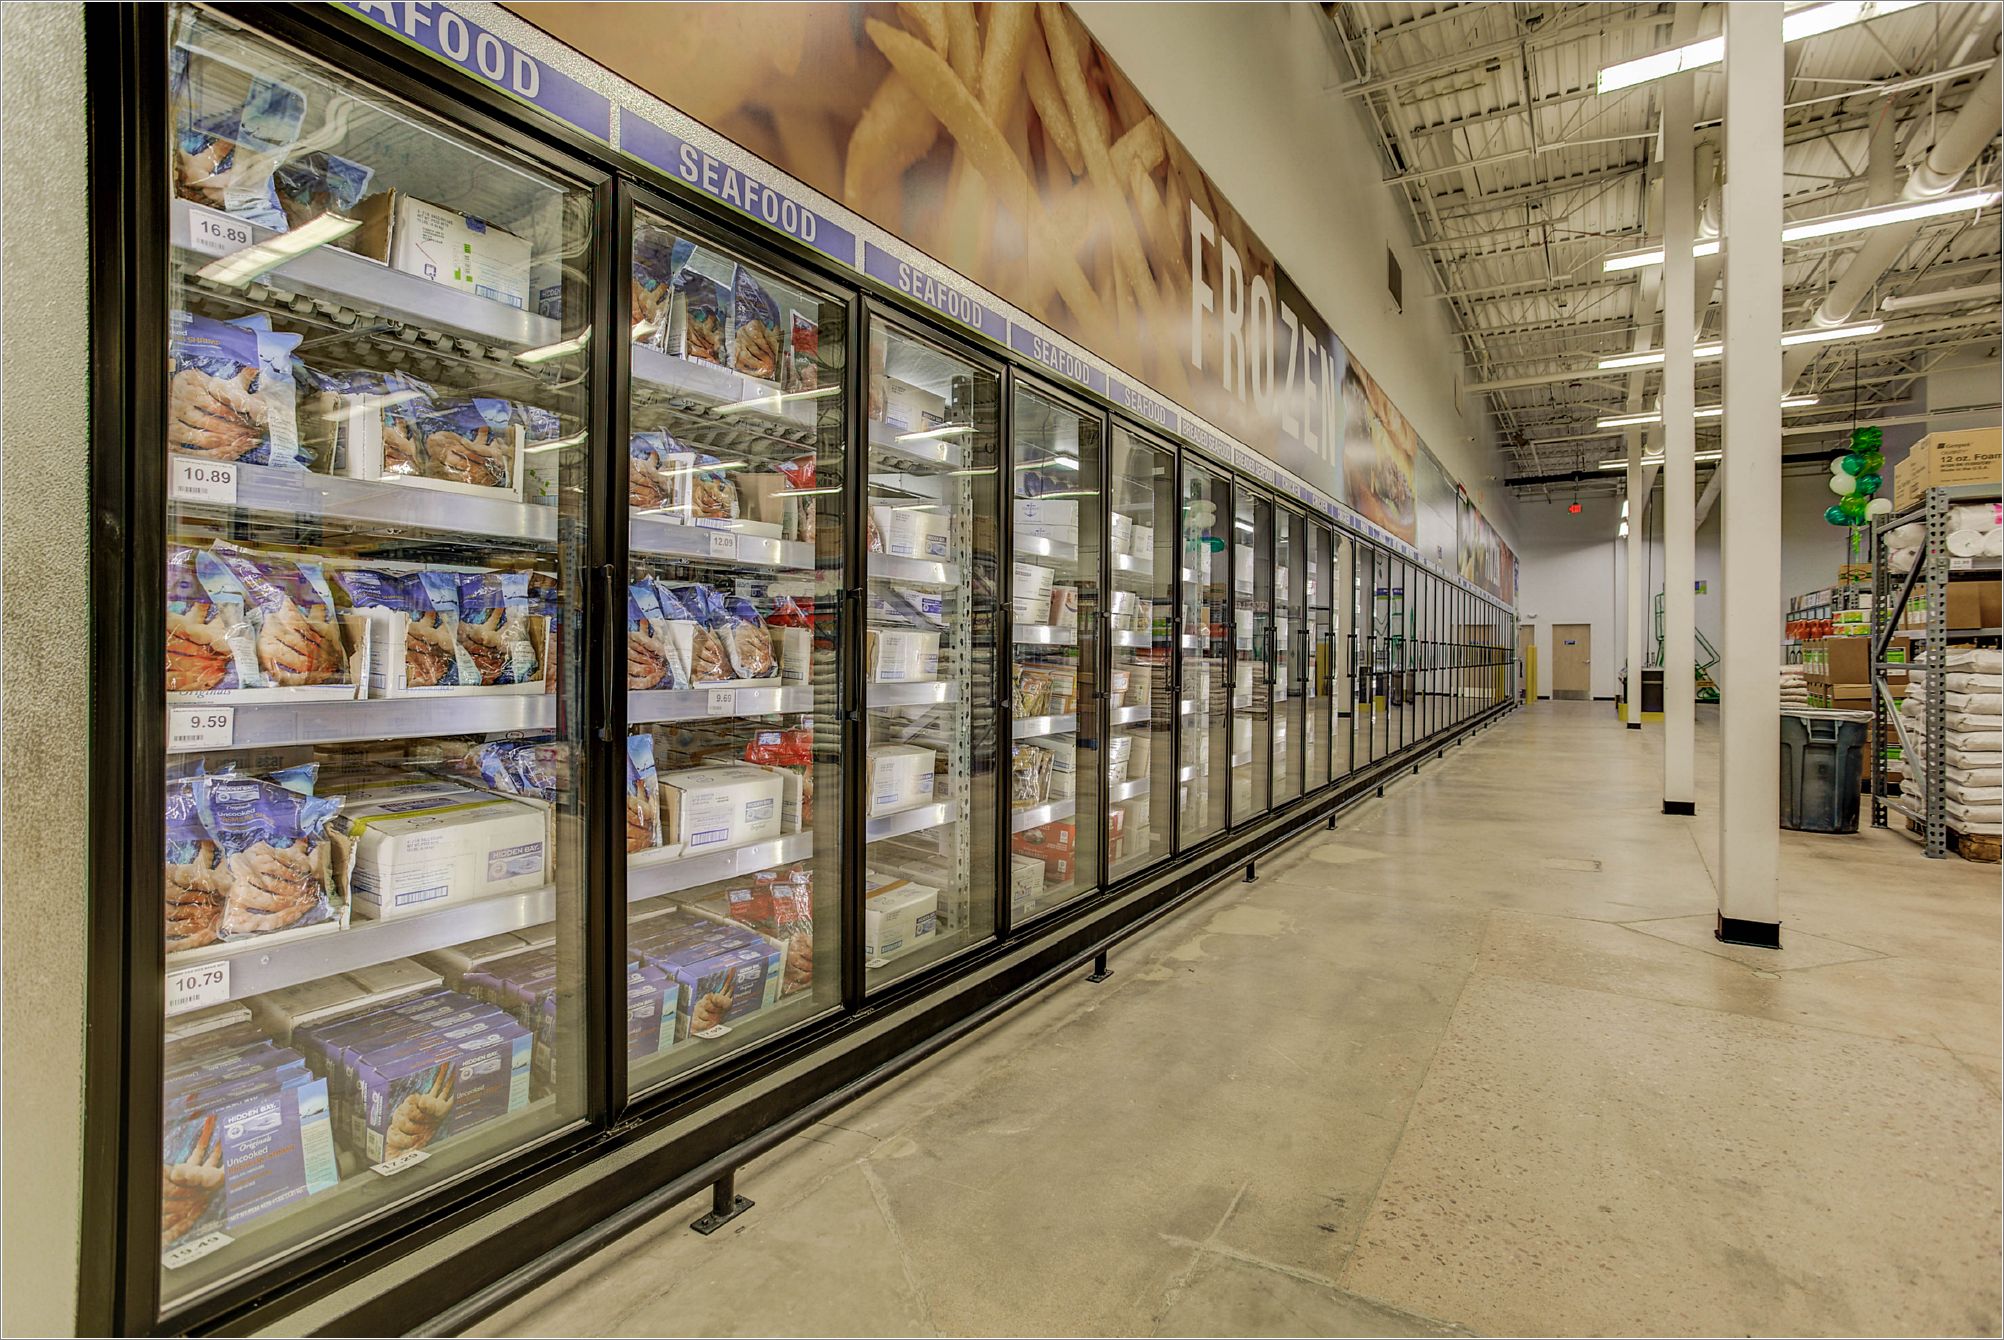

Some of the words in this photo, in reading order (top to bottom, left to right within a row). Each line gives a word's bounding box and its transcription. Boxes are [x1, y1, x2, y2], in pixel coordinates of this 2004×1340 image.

[679, 143, 817, 244] SEAFOOD
[201, 220, 247, 243] 16.89
[899, 264, 983, 330] SEAFOOD
[1190, 198, 1336, 467] FROZEN
[1033, 337, 1091, 385] SEAFOOD
[1124, 387, 1166, 425] SEAFOOD
[1182, 420, 1208, 446] BREADED
[1208, 435, 1231, 461] SEAFOOD
[184, 466, 231, 483] 10.89
[191, 715, 227, 728] 9.59
[218, 807, 257, 817] Uncooked
[492, 847, 523, 859] HIDDEN
[176, 970, 223, 991] 10.79
[463, 1055, 485, 1067] HIDDEN
[228, 1107, 260, 1123] HIDDEN
[226, 1146, 269, 1167] Uncooked
